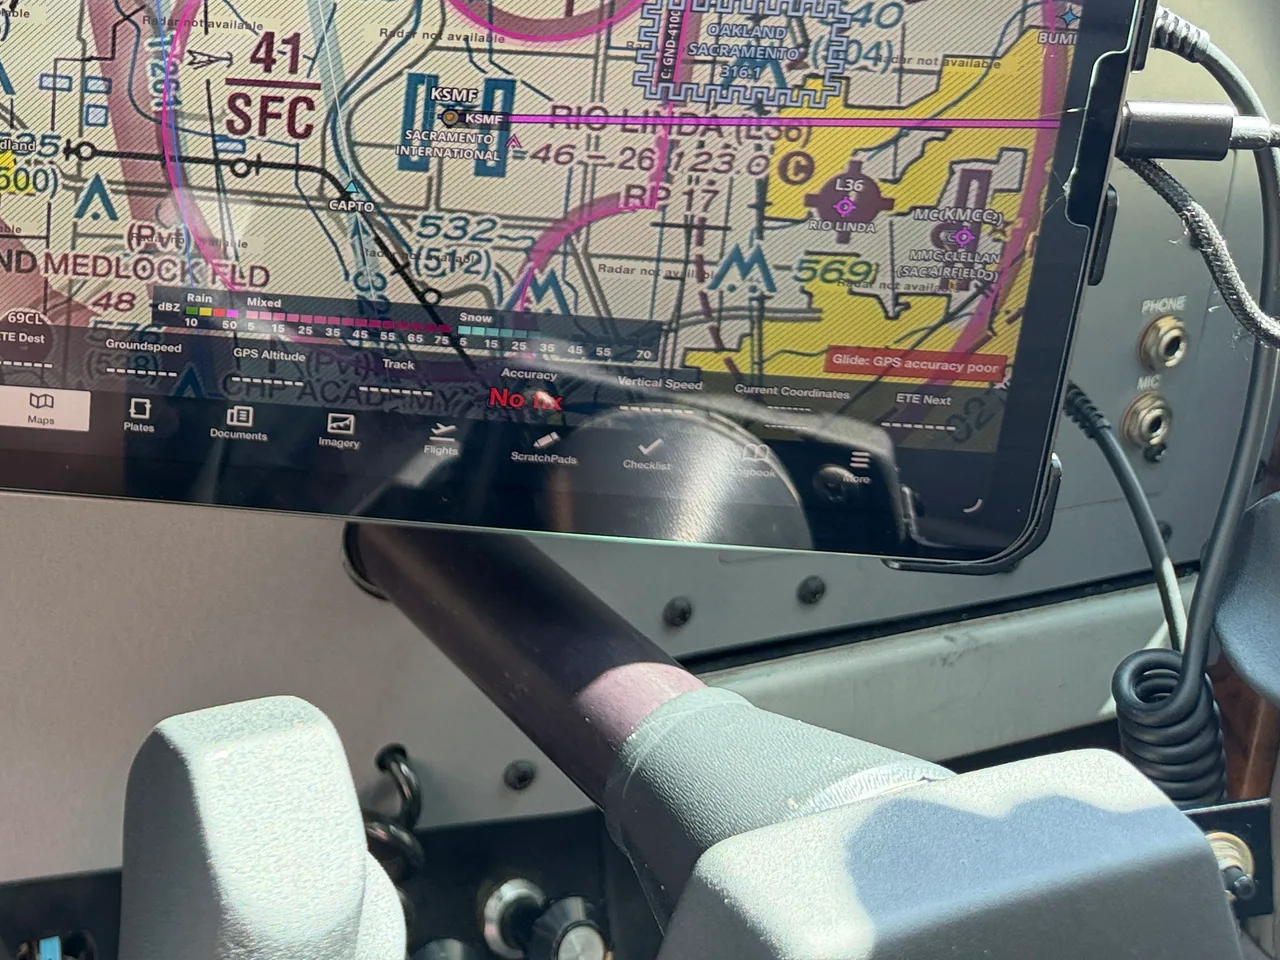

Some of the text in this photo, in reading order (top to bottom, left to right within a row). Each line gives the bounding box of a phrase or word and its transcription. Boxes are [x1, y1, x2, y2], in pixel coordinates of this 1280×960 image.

[707, 23, 787, 39] OAKLAND
[250, 32, 301, 74] 41
[688, 43, 799, 60] SACRAMENTO
[431, 88, 478, 103] KSMF
[226, 93, 315, 138] SFC
[465, 113, 503, 125] KSMF
[405, 129, 494, 144] SACRAMENTO
[395, 145, 501, 162] INTERNATIONAL
[835, 179, 863, 192] L36
[329, 199, 375, 214] CAPTO
[809, 220, 875, 234] RIO LINDA
[187, 293, 212, 304] Rain
[247, 297, 282, 309] Mixed
[1141, 295, 1187, 315] PHONE
[8, 311, 43, 325] 69CL
[459, 312, 492, 324] Snow
[106, 338, 182, 354] Groundspeed
[382, 359, 415, 371] Track
[832, 354, 999, 375] Glide: GPS accuracy poor
[501, 368, 557, 383] Accuracy
[1137, 374, 1161, 390] MIC
[618, 376, 703, 392] Vertical Speed
[735, 384, 850, 401] Current Coordinates
[896, 393, 951, 407] ETE Next
[27, 414, 55, 426] Maps
[124, 422, 155, 434] Plates
[210, 428, 267, 442] Documents
[510, 451, 577, 466] ScratchPads
[623, 458, 672, 472] Checklist
